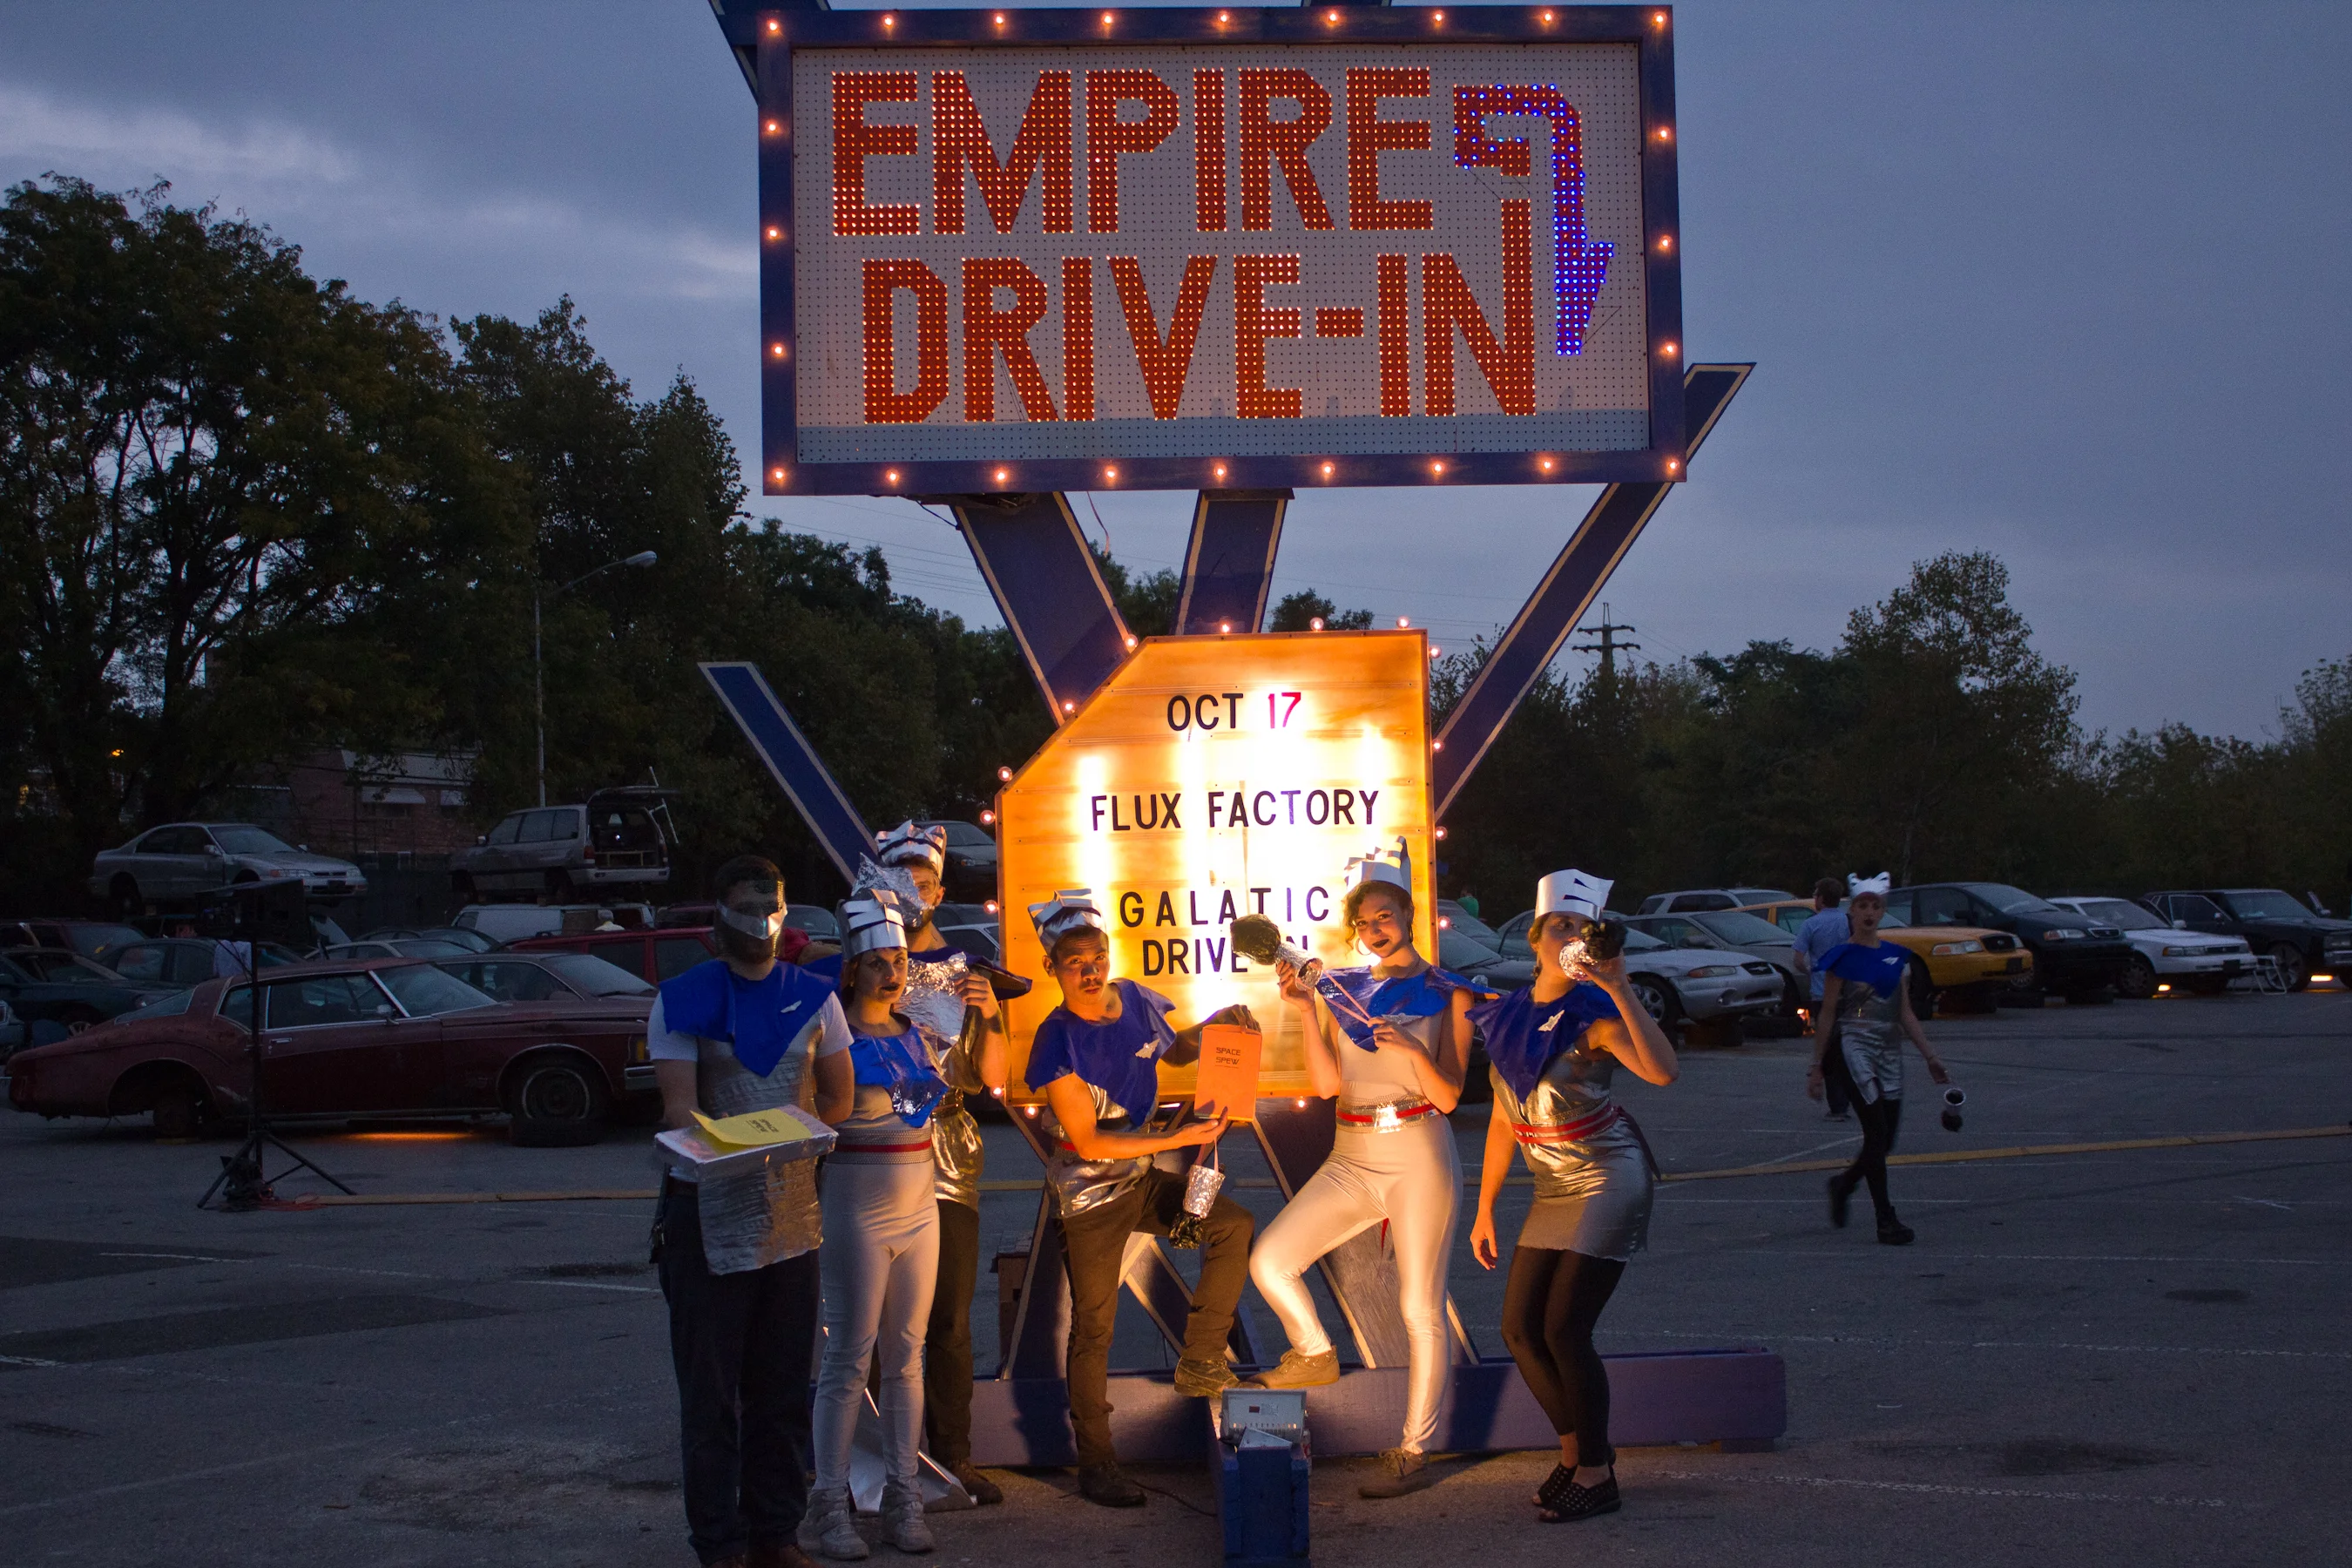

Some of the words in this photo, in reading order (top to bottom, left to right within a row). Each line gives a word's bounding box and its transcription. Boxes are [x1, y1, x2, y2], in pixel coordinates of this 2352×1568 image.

[831, 67, 1434, 236] EMPIRE
[862, 199, 1536, 424] DRIVE-IN
[1166, 693, 1244, 732] OCT
[1267, 692, 1301, 729] 17
[1091, 792, 1181, 831] FLUX
[1207, 789, 1379, 828] FACTORY
[1119, 886, 1330, 928] GALATIC
[1215, 1046, 1241, 1057] SPACE
[1215, 1056, 1240, 1065] SPEW
